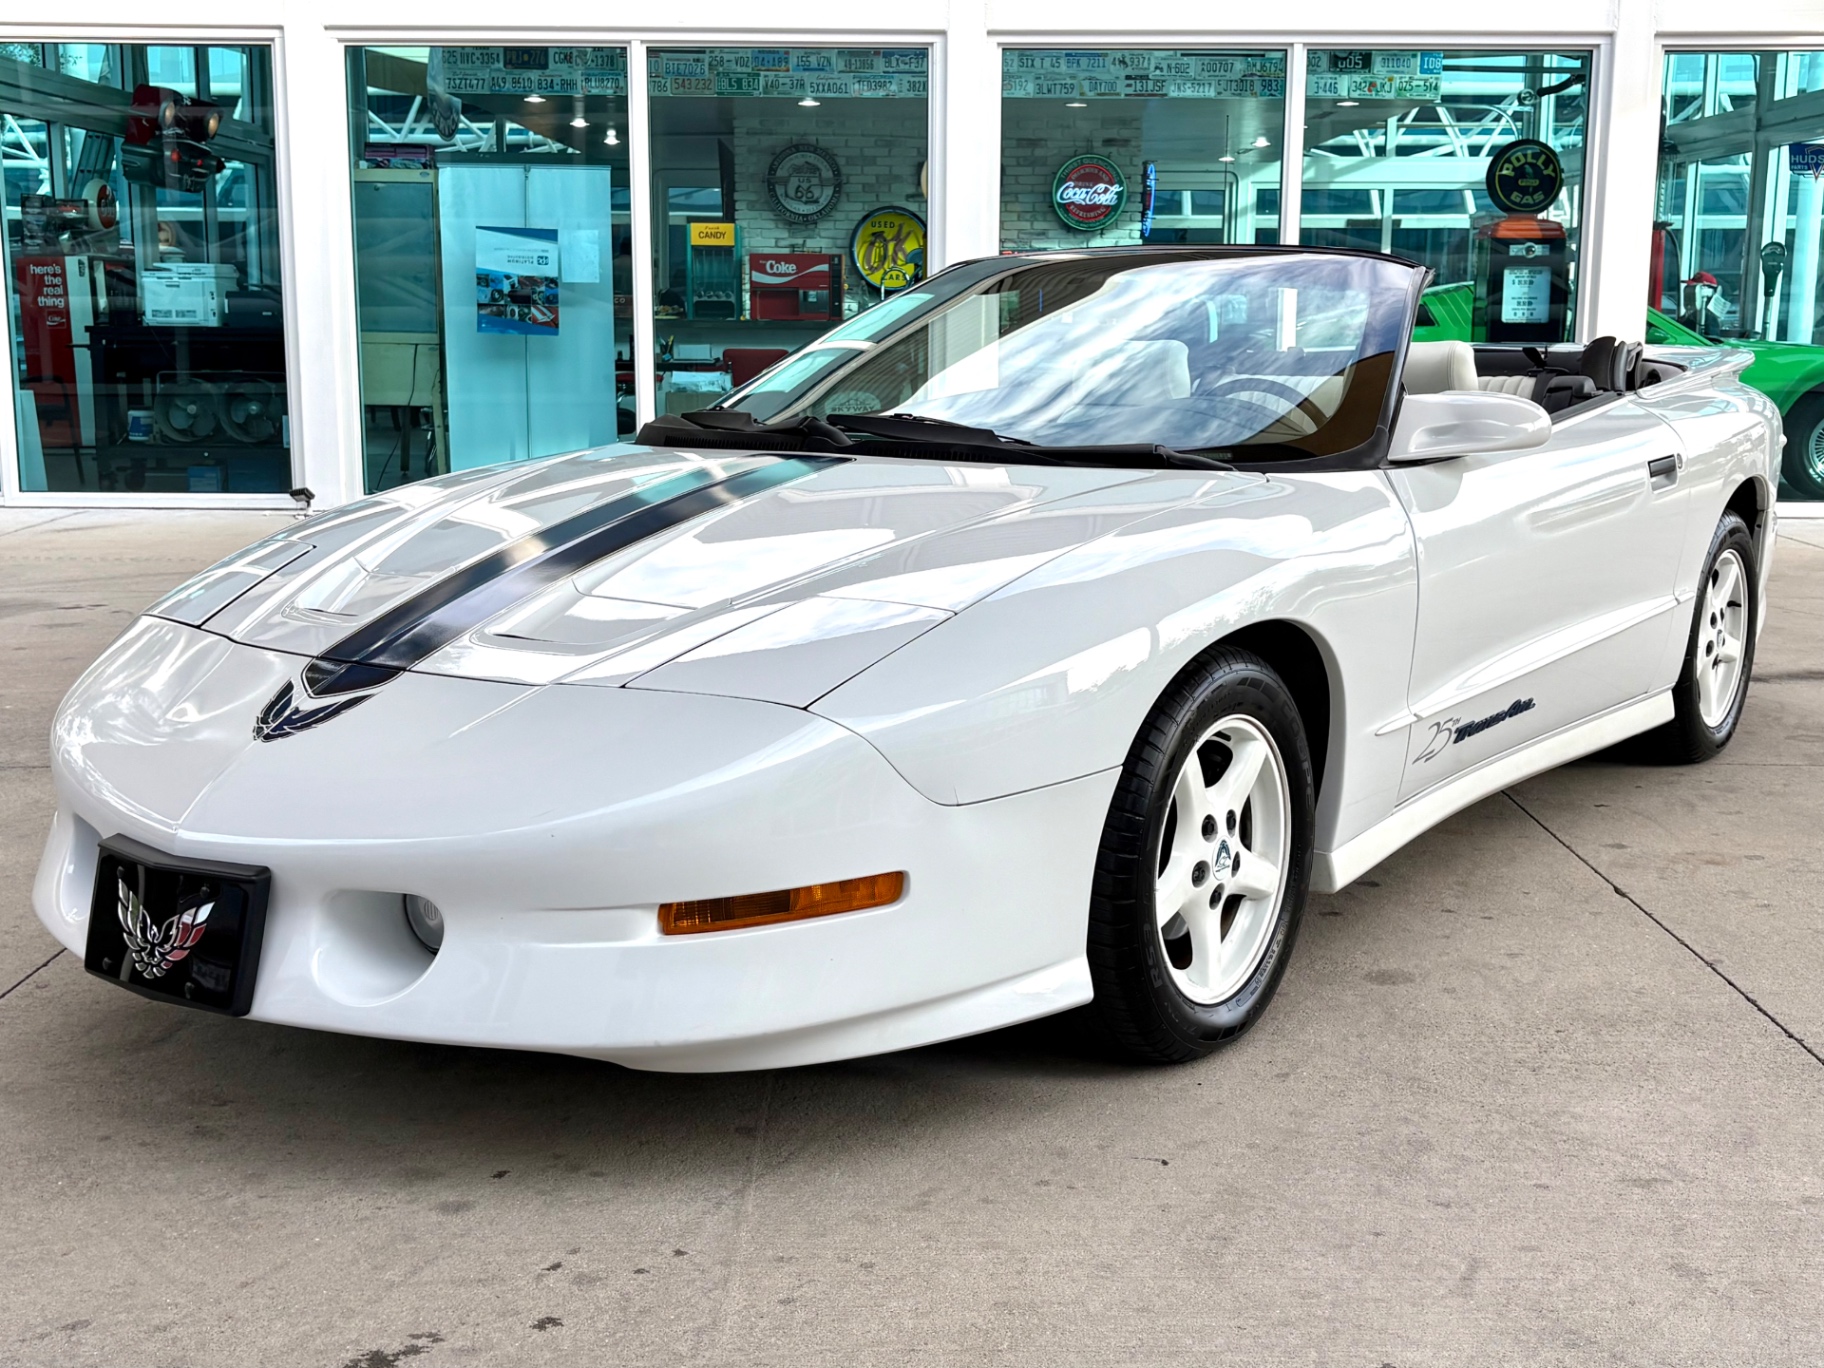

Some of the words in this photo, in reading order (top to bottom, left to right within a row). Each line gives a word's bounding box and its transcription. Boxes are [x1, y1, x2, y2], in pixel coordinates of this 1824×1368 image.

[1502, 150, 1556, 178] POLLY
[795, 185, 814, 200] 66
[1056, 182, 1124, 206] Coca-Cola
[1510, 191, 1545, 205] GAS
[871, 221, 896, 229] USED
[698, 231, 727, 240] CANDY
[30, 263, 62, 275] here's
[766, 260, 797, 274] Coke
[44, 275, 62, 286] the
[43, 285, 64, 295] real
[37, 296, 65, 309] thing
